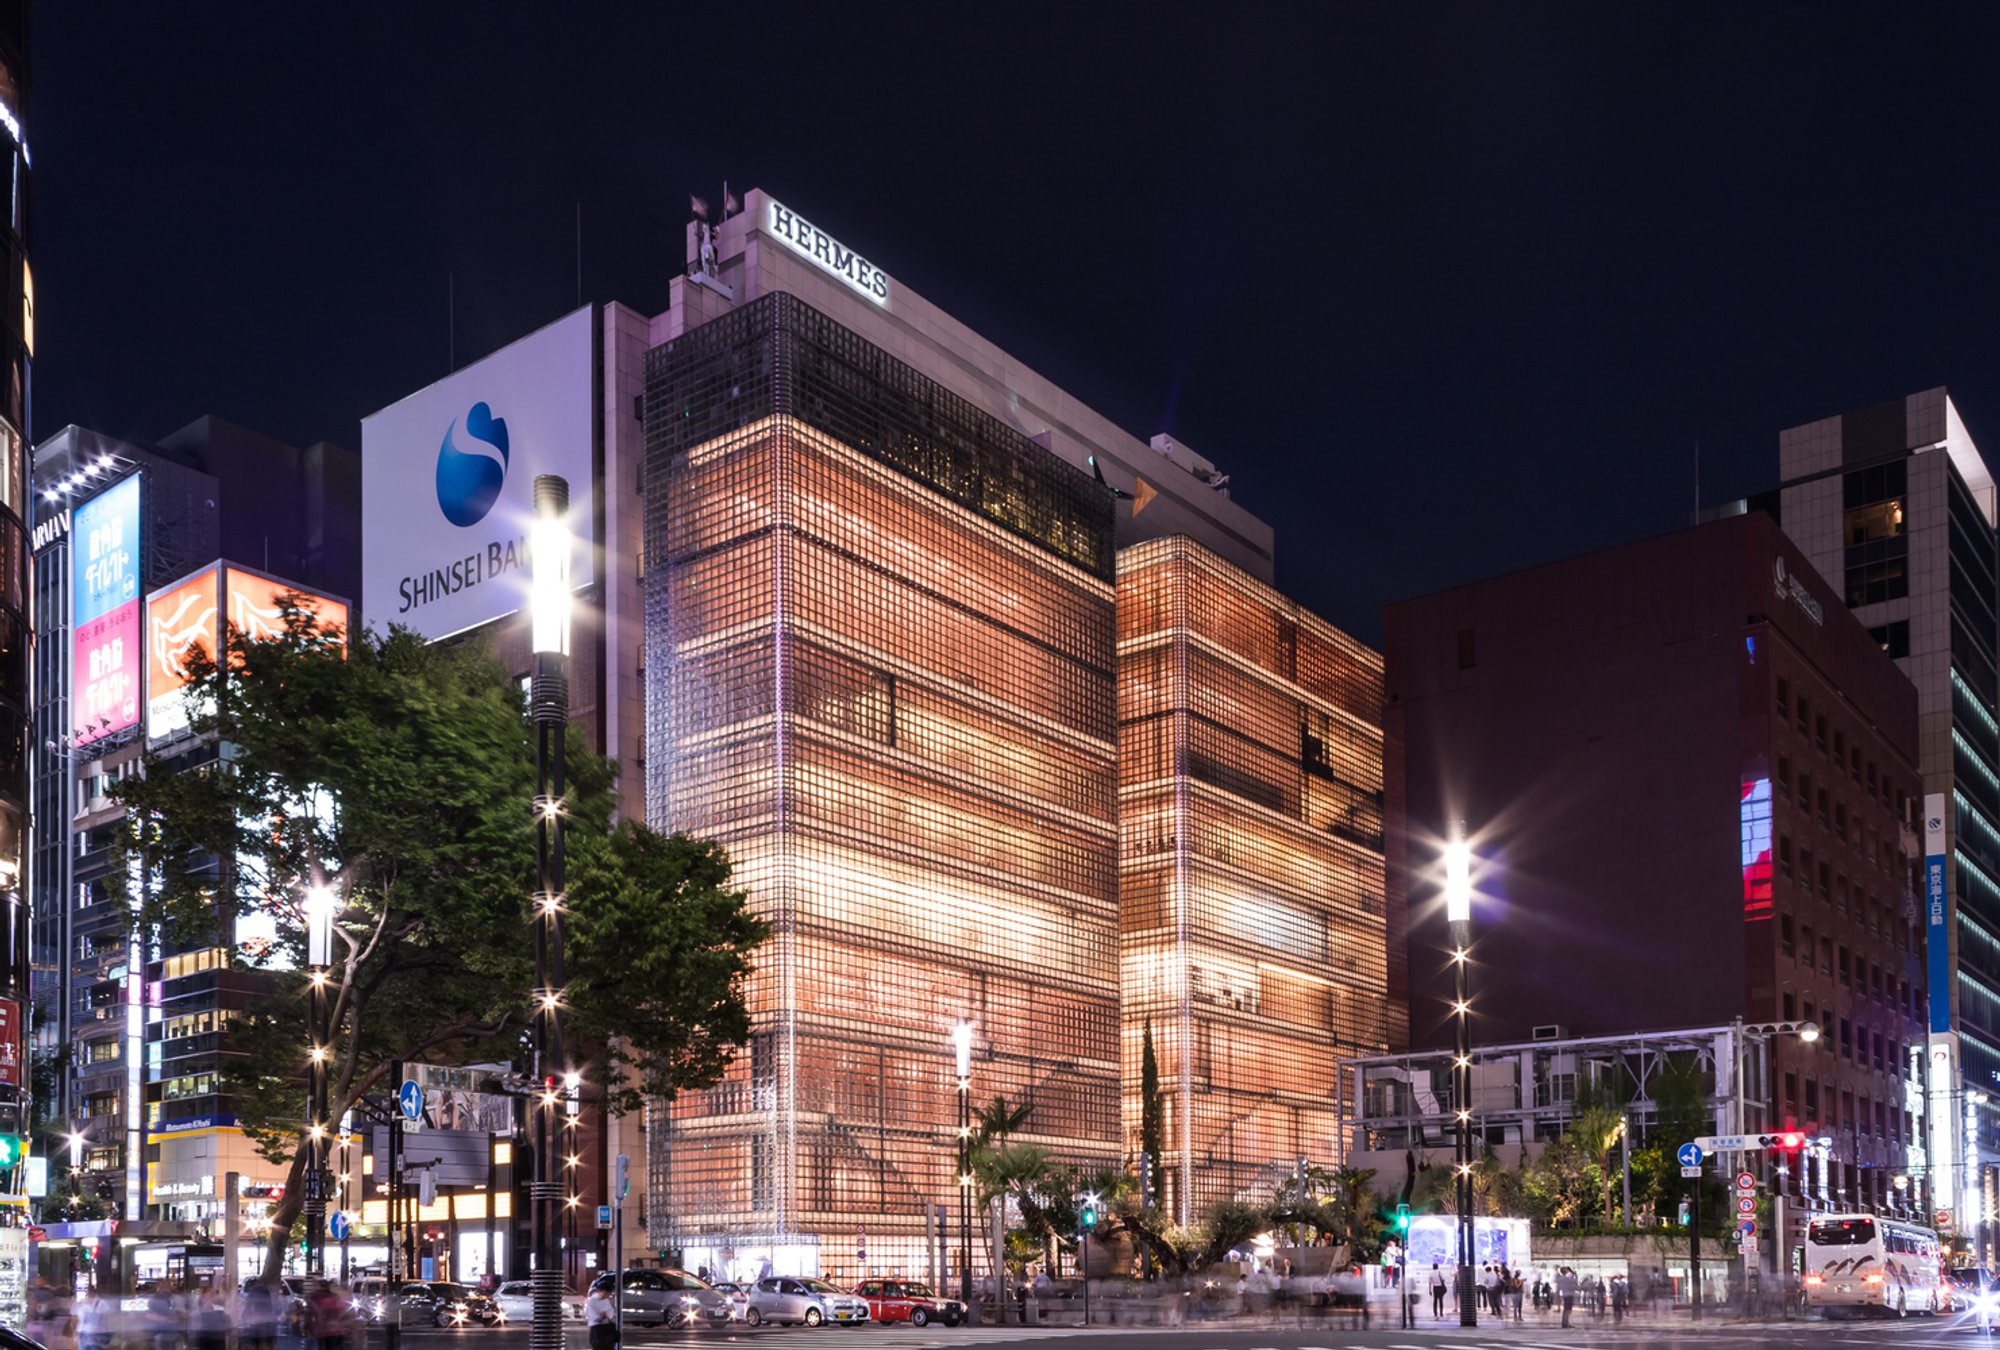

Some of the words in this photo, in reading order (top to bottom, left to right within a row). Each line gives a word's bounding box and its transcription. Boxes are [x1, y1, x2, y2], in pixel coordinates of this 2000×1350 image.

[399, 552, 482, 613] SHINSEI
[487, 535, 533, 579] BAN
[1930, 864, 1943, 926] 東京海上日動
